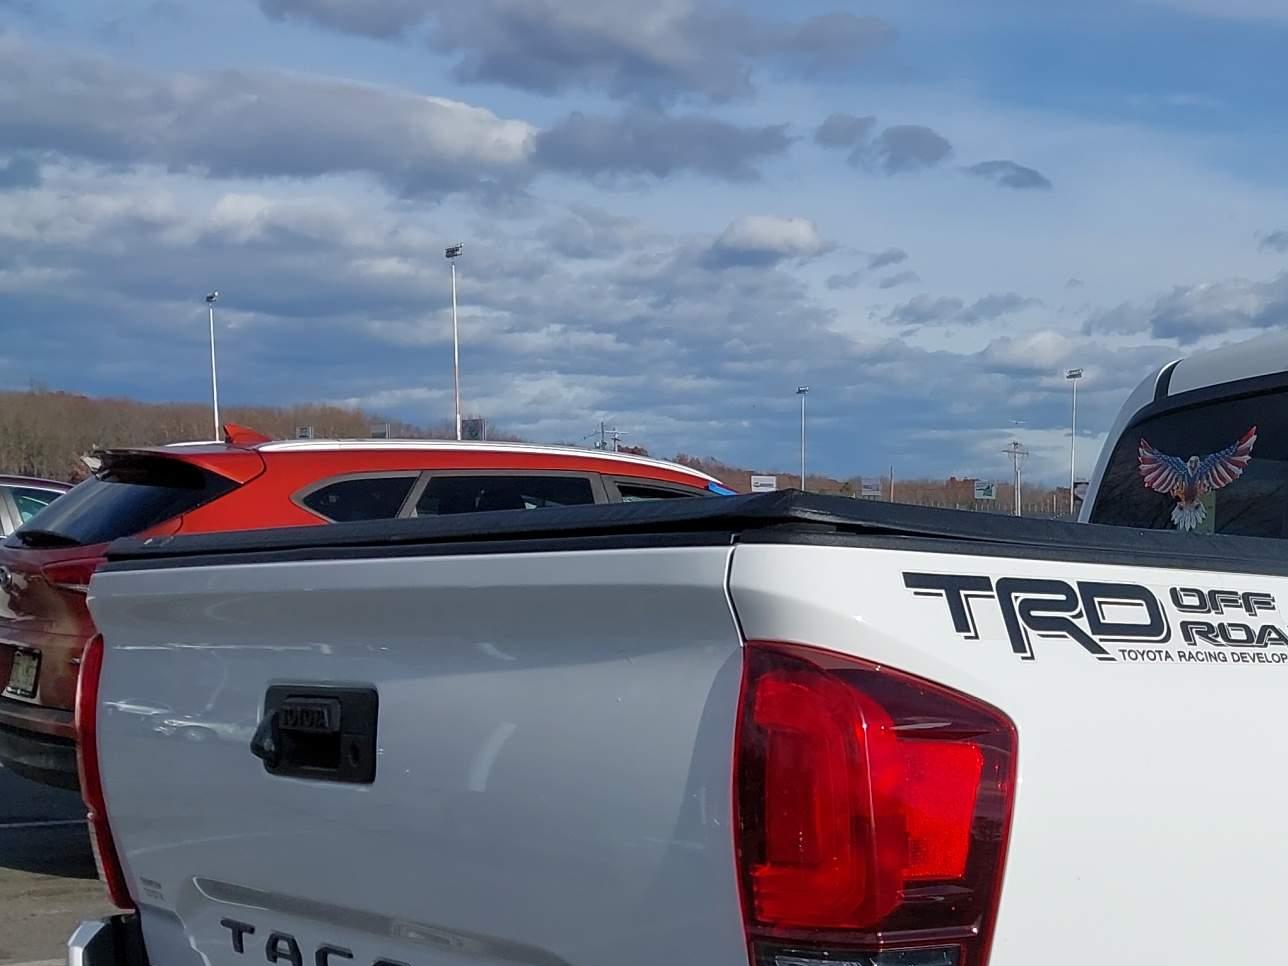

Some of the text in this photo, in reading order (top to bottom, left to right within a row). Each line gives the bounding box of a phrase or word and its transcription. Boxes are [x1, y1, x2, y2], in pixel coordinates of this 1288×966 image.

[1169, 586, 1276, 616] OFF
[902, 571, 1172, 662] TRD
[1118, 649, 1174, 662] TOYOTA
[1177, 650, 1228, 663] RACING
